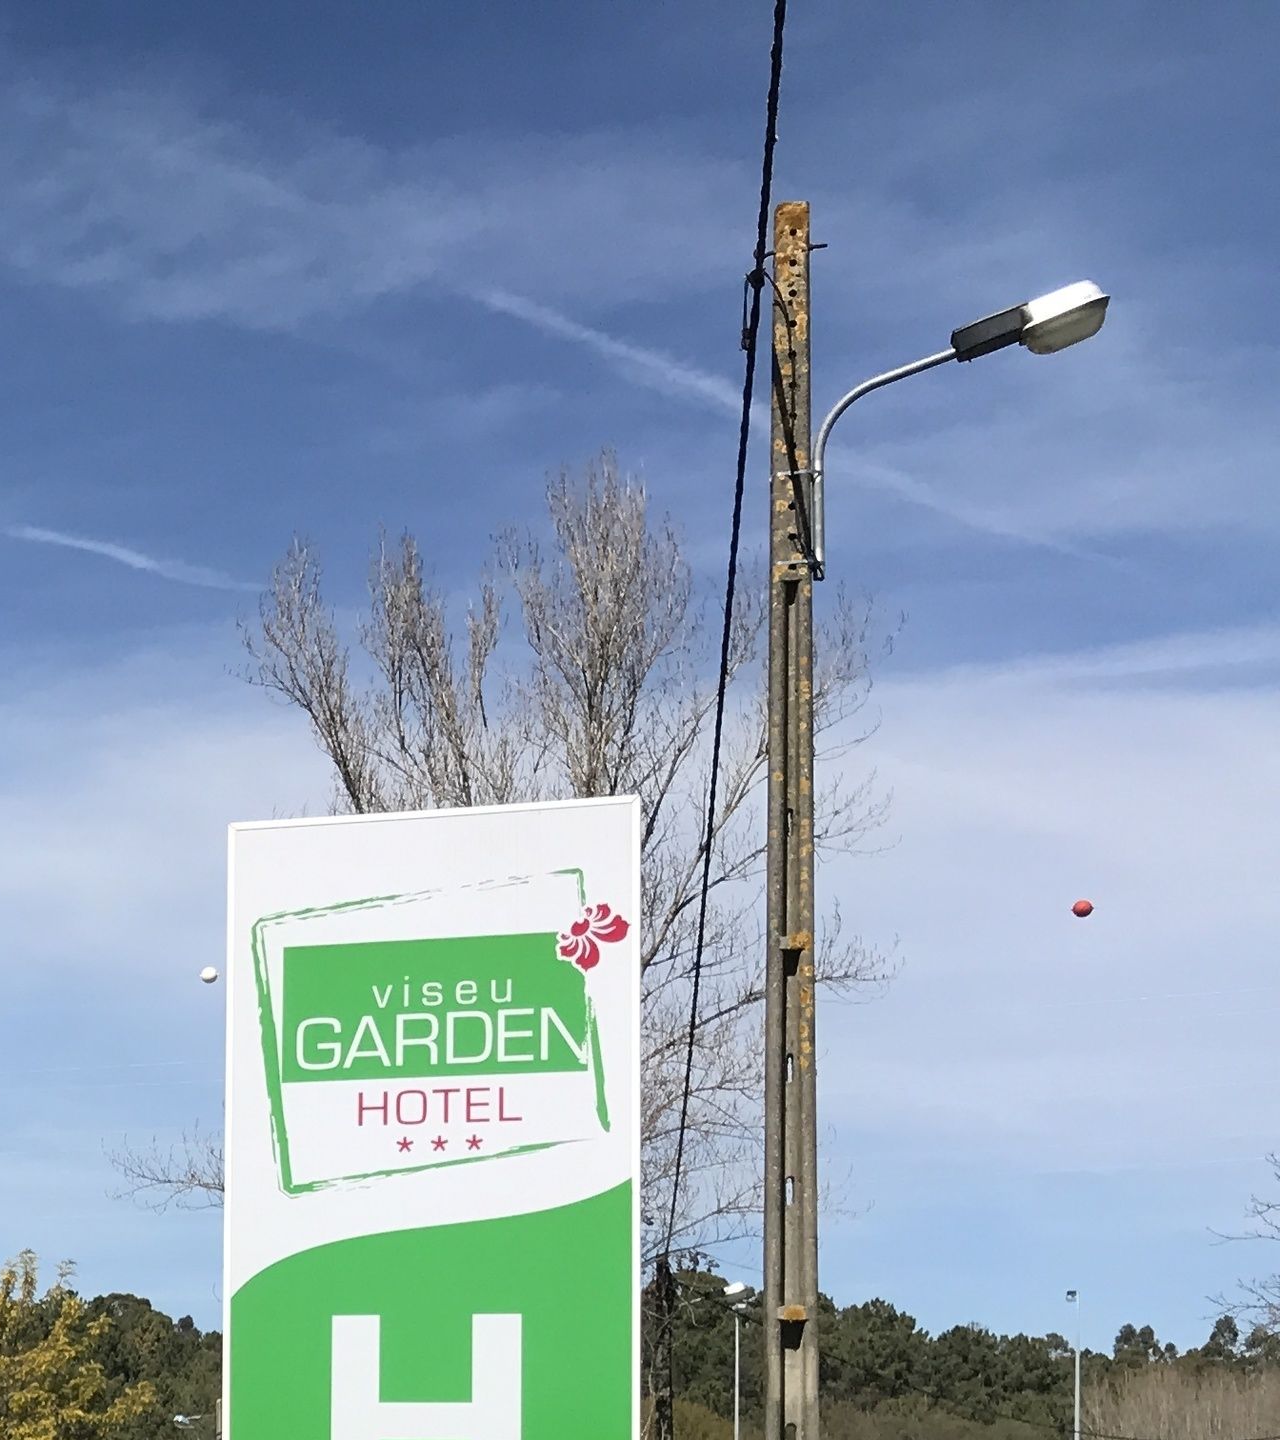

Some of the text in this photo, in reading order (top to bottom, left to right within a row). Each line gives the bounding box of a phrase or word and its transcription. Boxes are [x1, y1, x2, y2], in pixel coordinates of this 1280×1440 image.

[372, 975, 513, 1009] viseu
[295, 1006, 590, 1071] GARDEN
[357, 1086, 523, 1127] HOTEL
